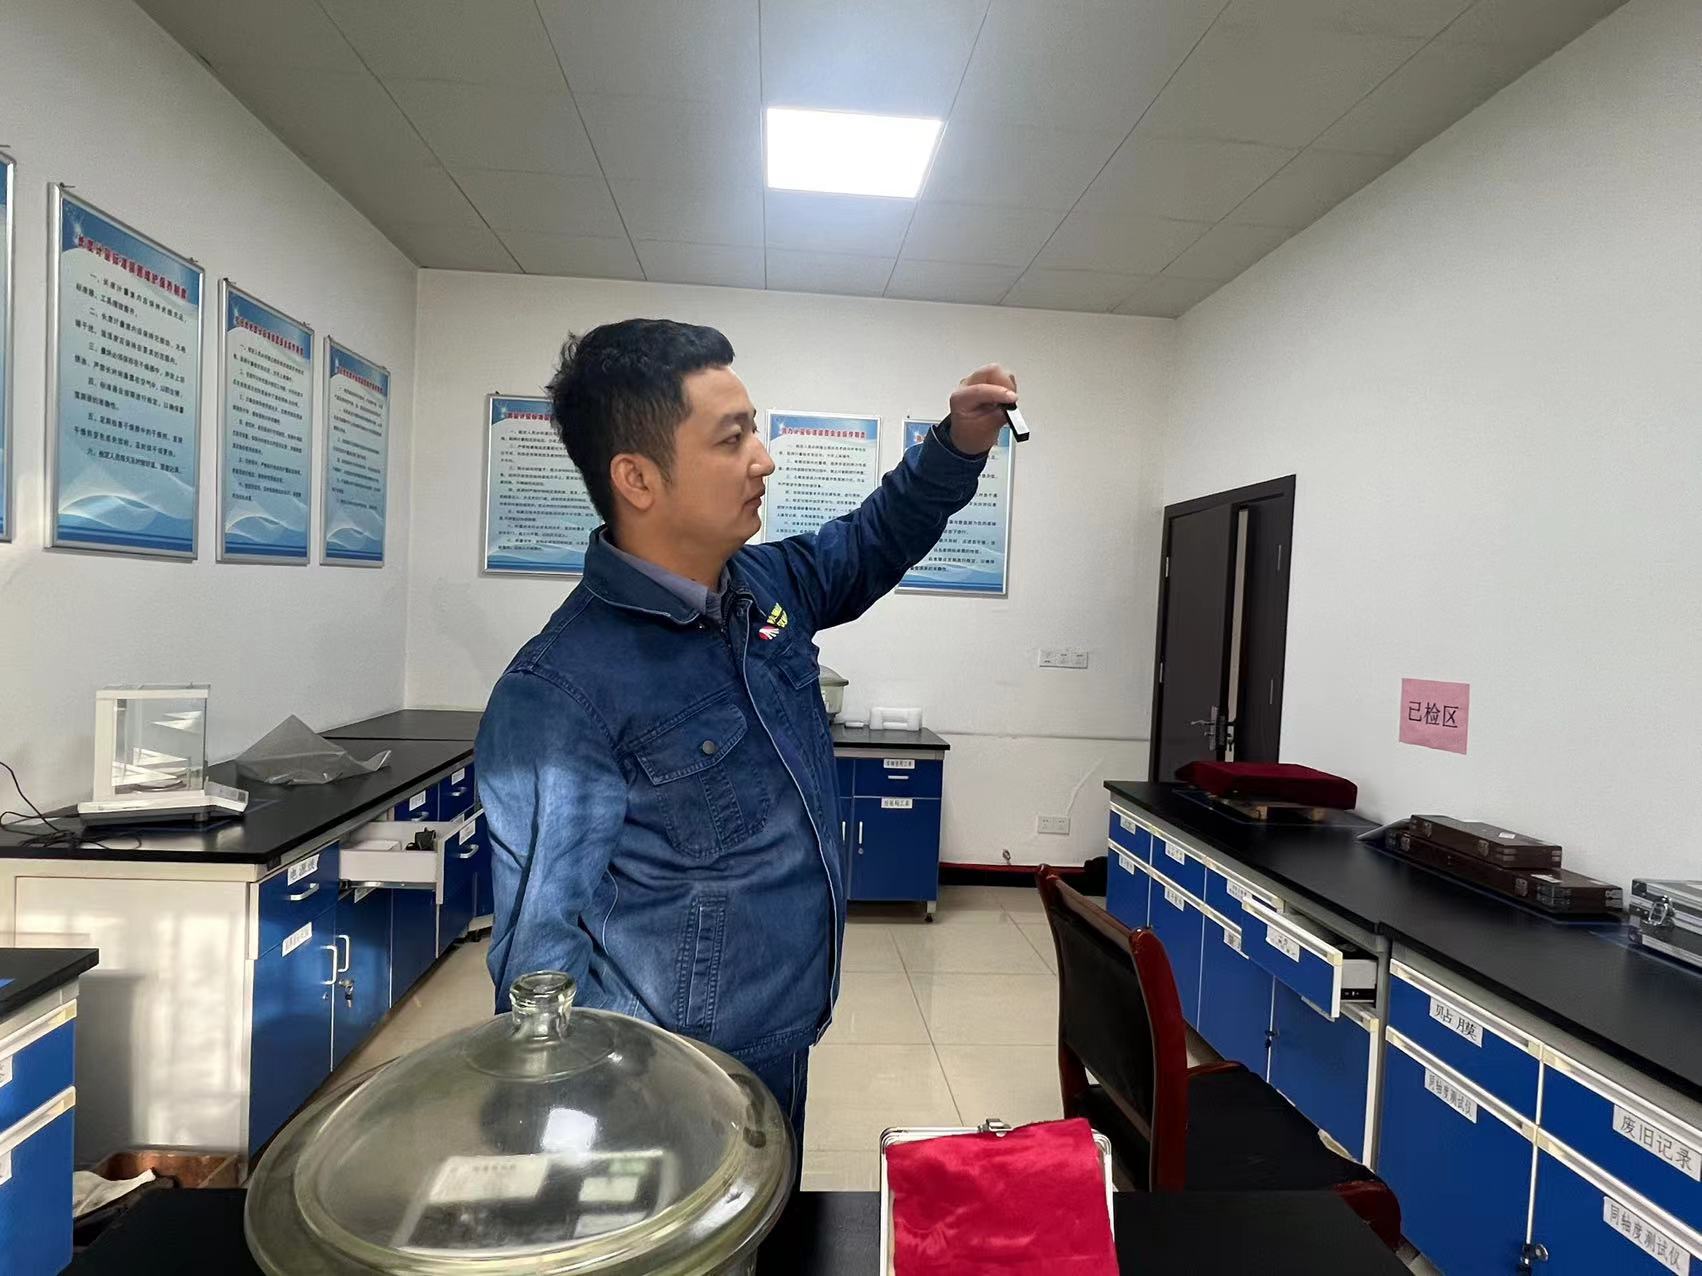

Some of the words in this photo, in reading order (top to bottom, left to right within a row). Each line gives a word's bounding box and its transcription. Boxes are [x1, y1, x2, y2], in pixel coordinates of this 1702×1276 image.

[1408, 701, 1459, 728] 已检区
[1621, 1115, 1692, 1171] 废旧记录
